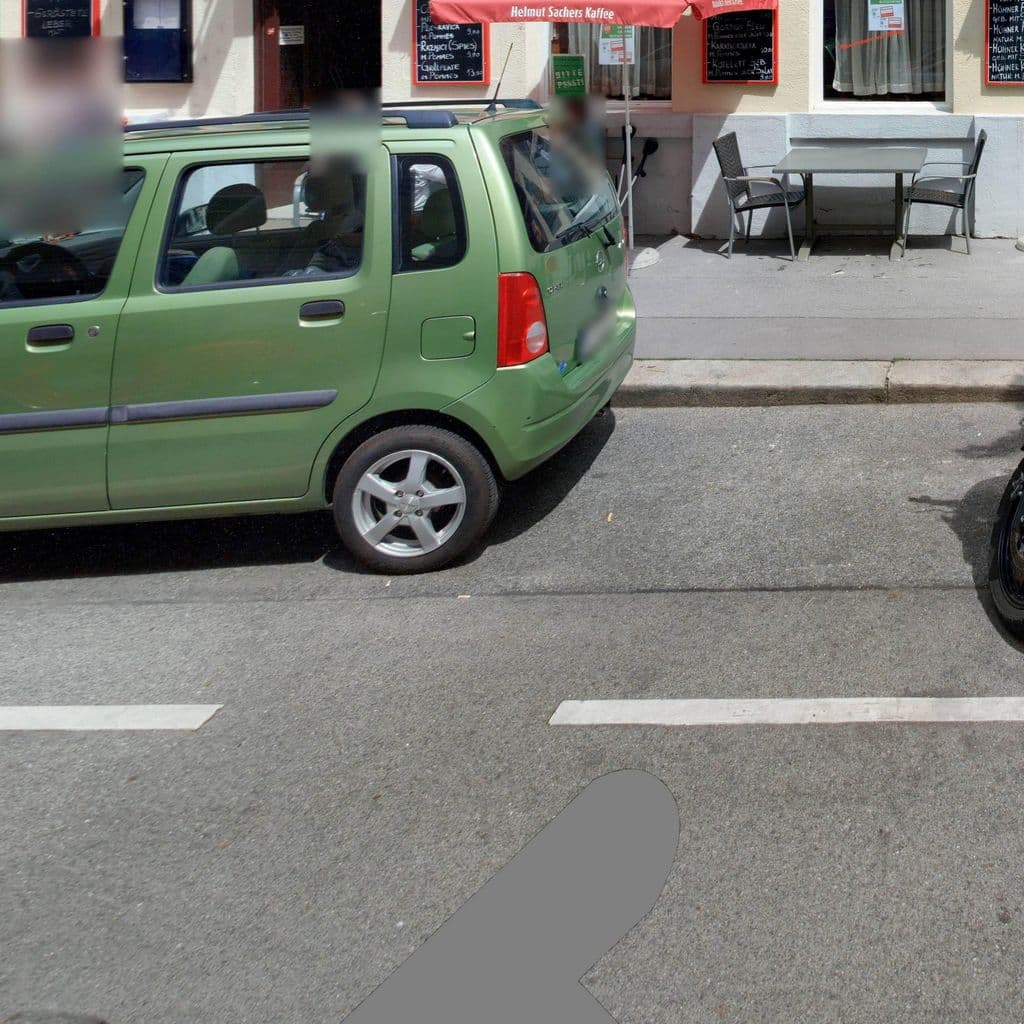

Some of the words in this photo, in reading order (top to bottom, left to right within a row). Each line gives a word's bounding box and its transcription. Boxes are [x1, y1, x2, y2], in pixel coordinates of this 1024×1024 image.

[511, 5, 546, 17] Helmut
[548, 6, 583, 19] Sachers
[585, 7, 614, 19] Kaffee
